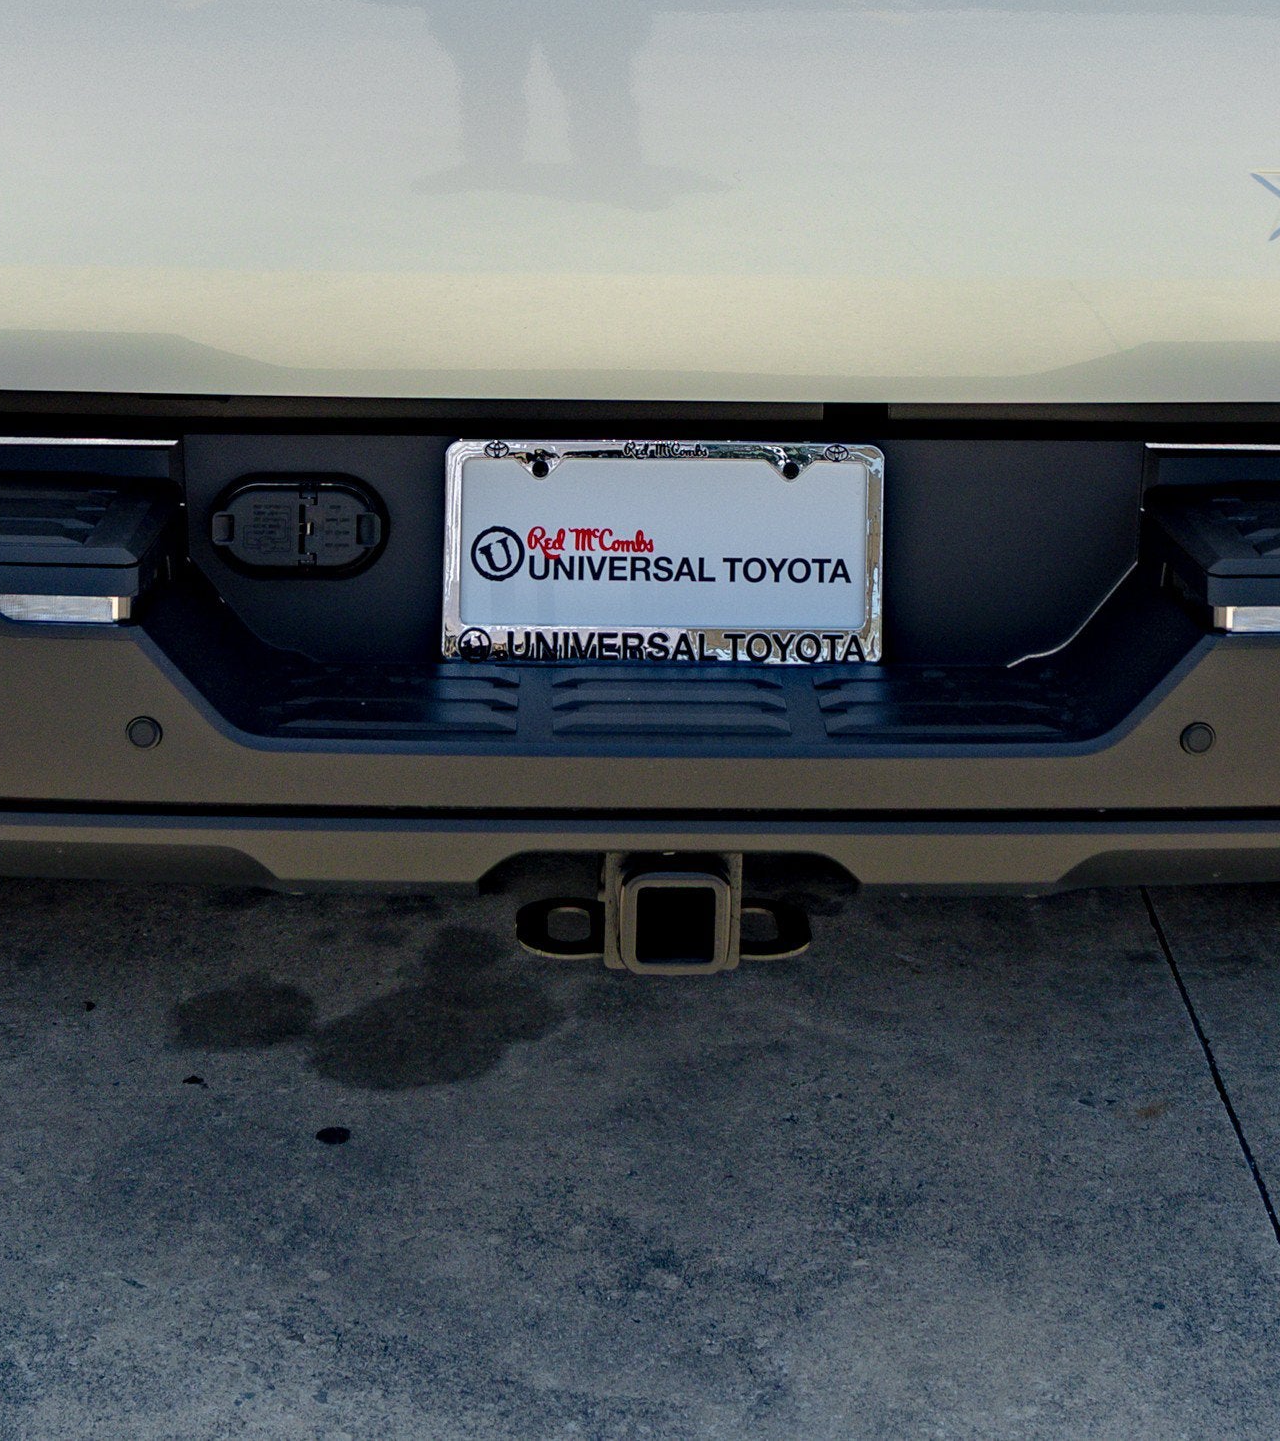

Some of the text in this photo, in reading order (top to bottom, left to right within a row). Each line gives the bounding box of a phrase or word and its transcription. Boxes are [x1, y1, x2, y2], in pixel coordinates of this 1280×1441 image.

[623, 441, 650, 460] Red
[526, 525, 566, 560] Red
[528, 555, 853, 584] UNIVERSAL TOYOTA
[507, 630, 867, 662] UNIVERSAL TOYOTA
